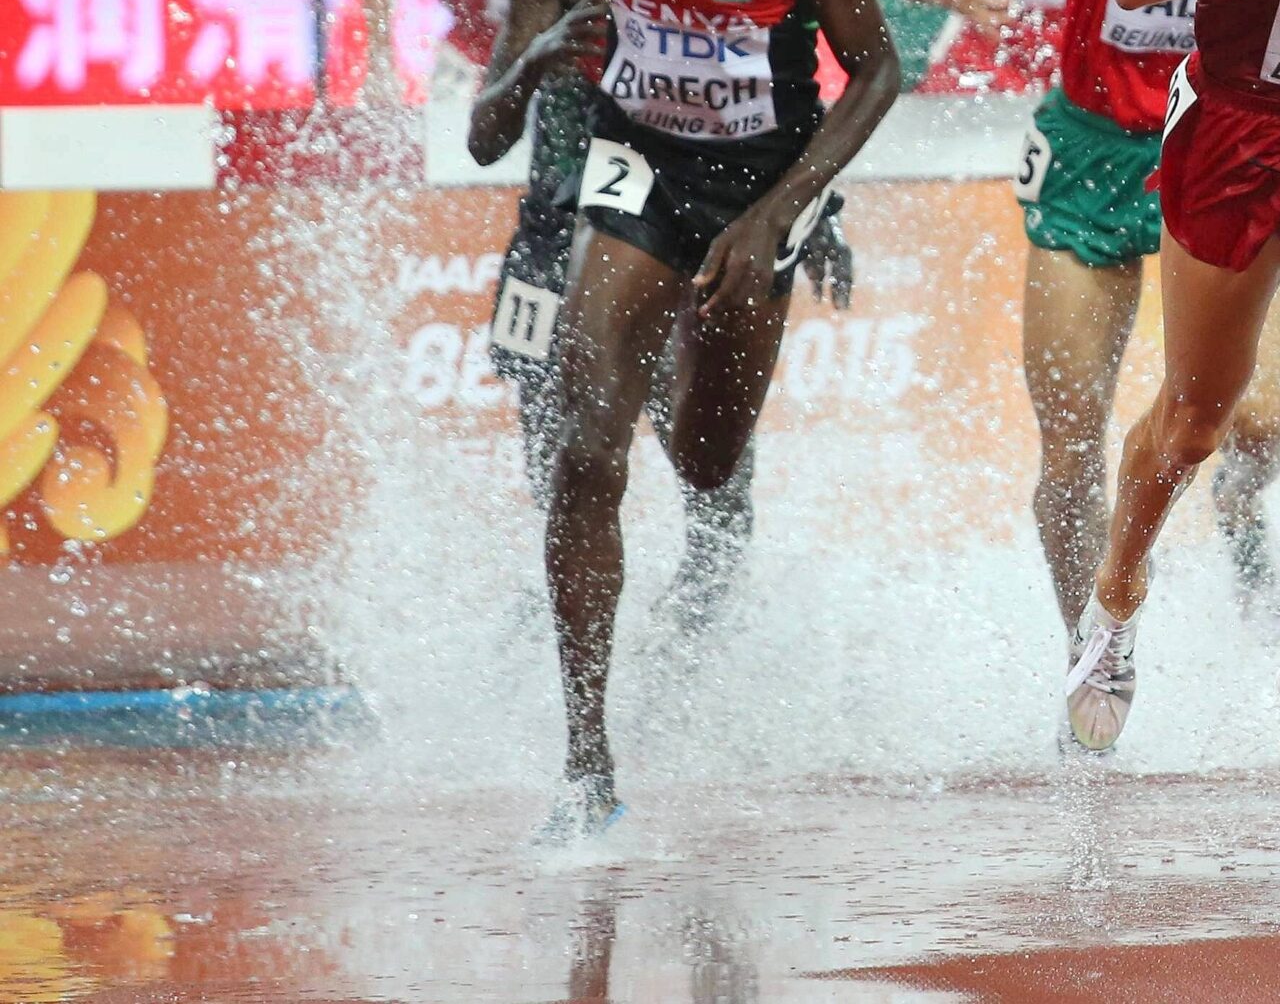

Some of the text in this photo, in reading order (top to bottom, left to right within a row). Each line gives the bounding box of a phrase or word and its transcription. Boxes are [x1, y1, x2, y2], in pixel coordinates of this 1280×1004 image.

[647, 25, 751, 62] TDK
[1109, 24, 1195, 49] BEIJING
[611, 58, 758, 110] BIRECH
[709, 111, 765, 136] 2015
[594, 156, 631, 197] 2
[509, 295, 541, 343] 11
